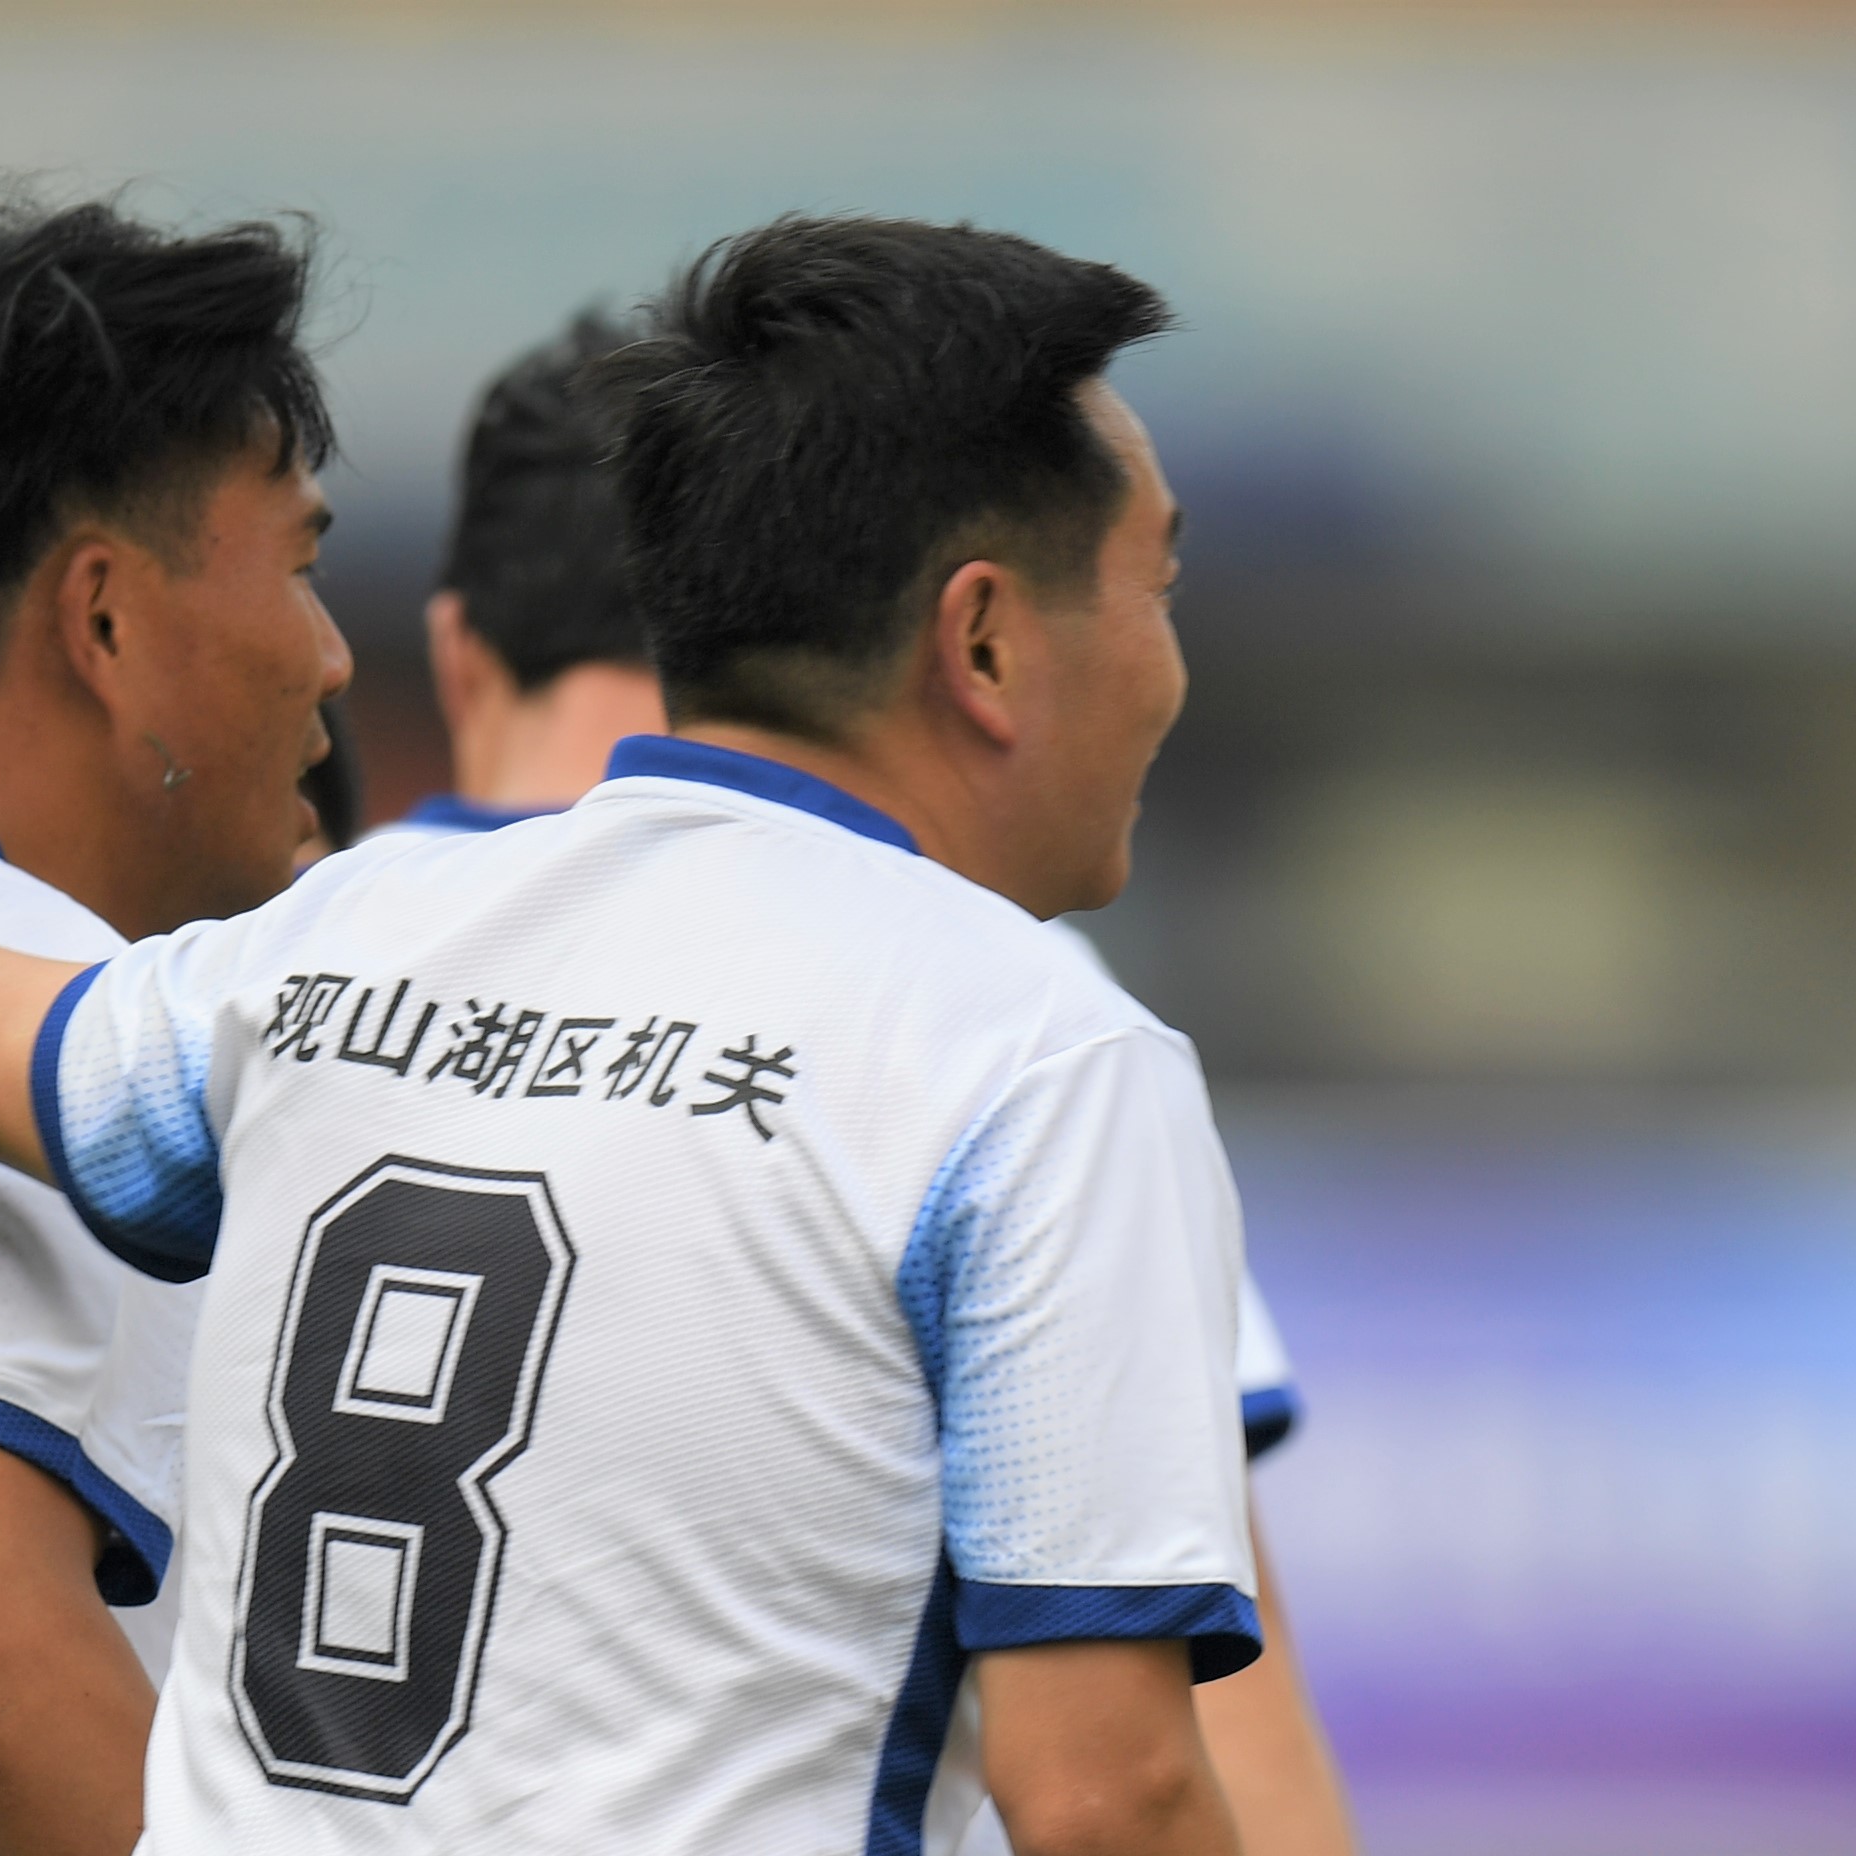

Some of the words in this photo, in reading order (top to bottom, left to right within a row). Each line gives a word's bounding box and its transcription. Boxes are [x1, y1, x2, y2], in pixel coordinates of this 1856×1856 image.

[261, 972, 798, 1142] 观山湖区机关
[228, 1153, 577, 1807] 8
